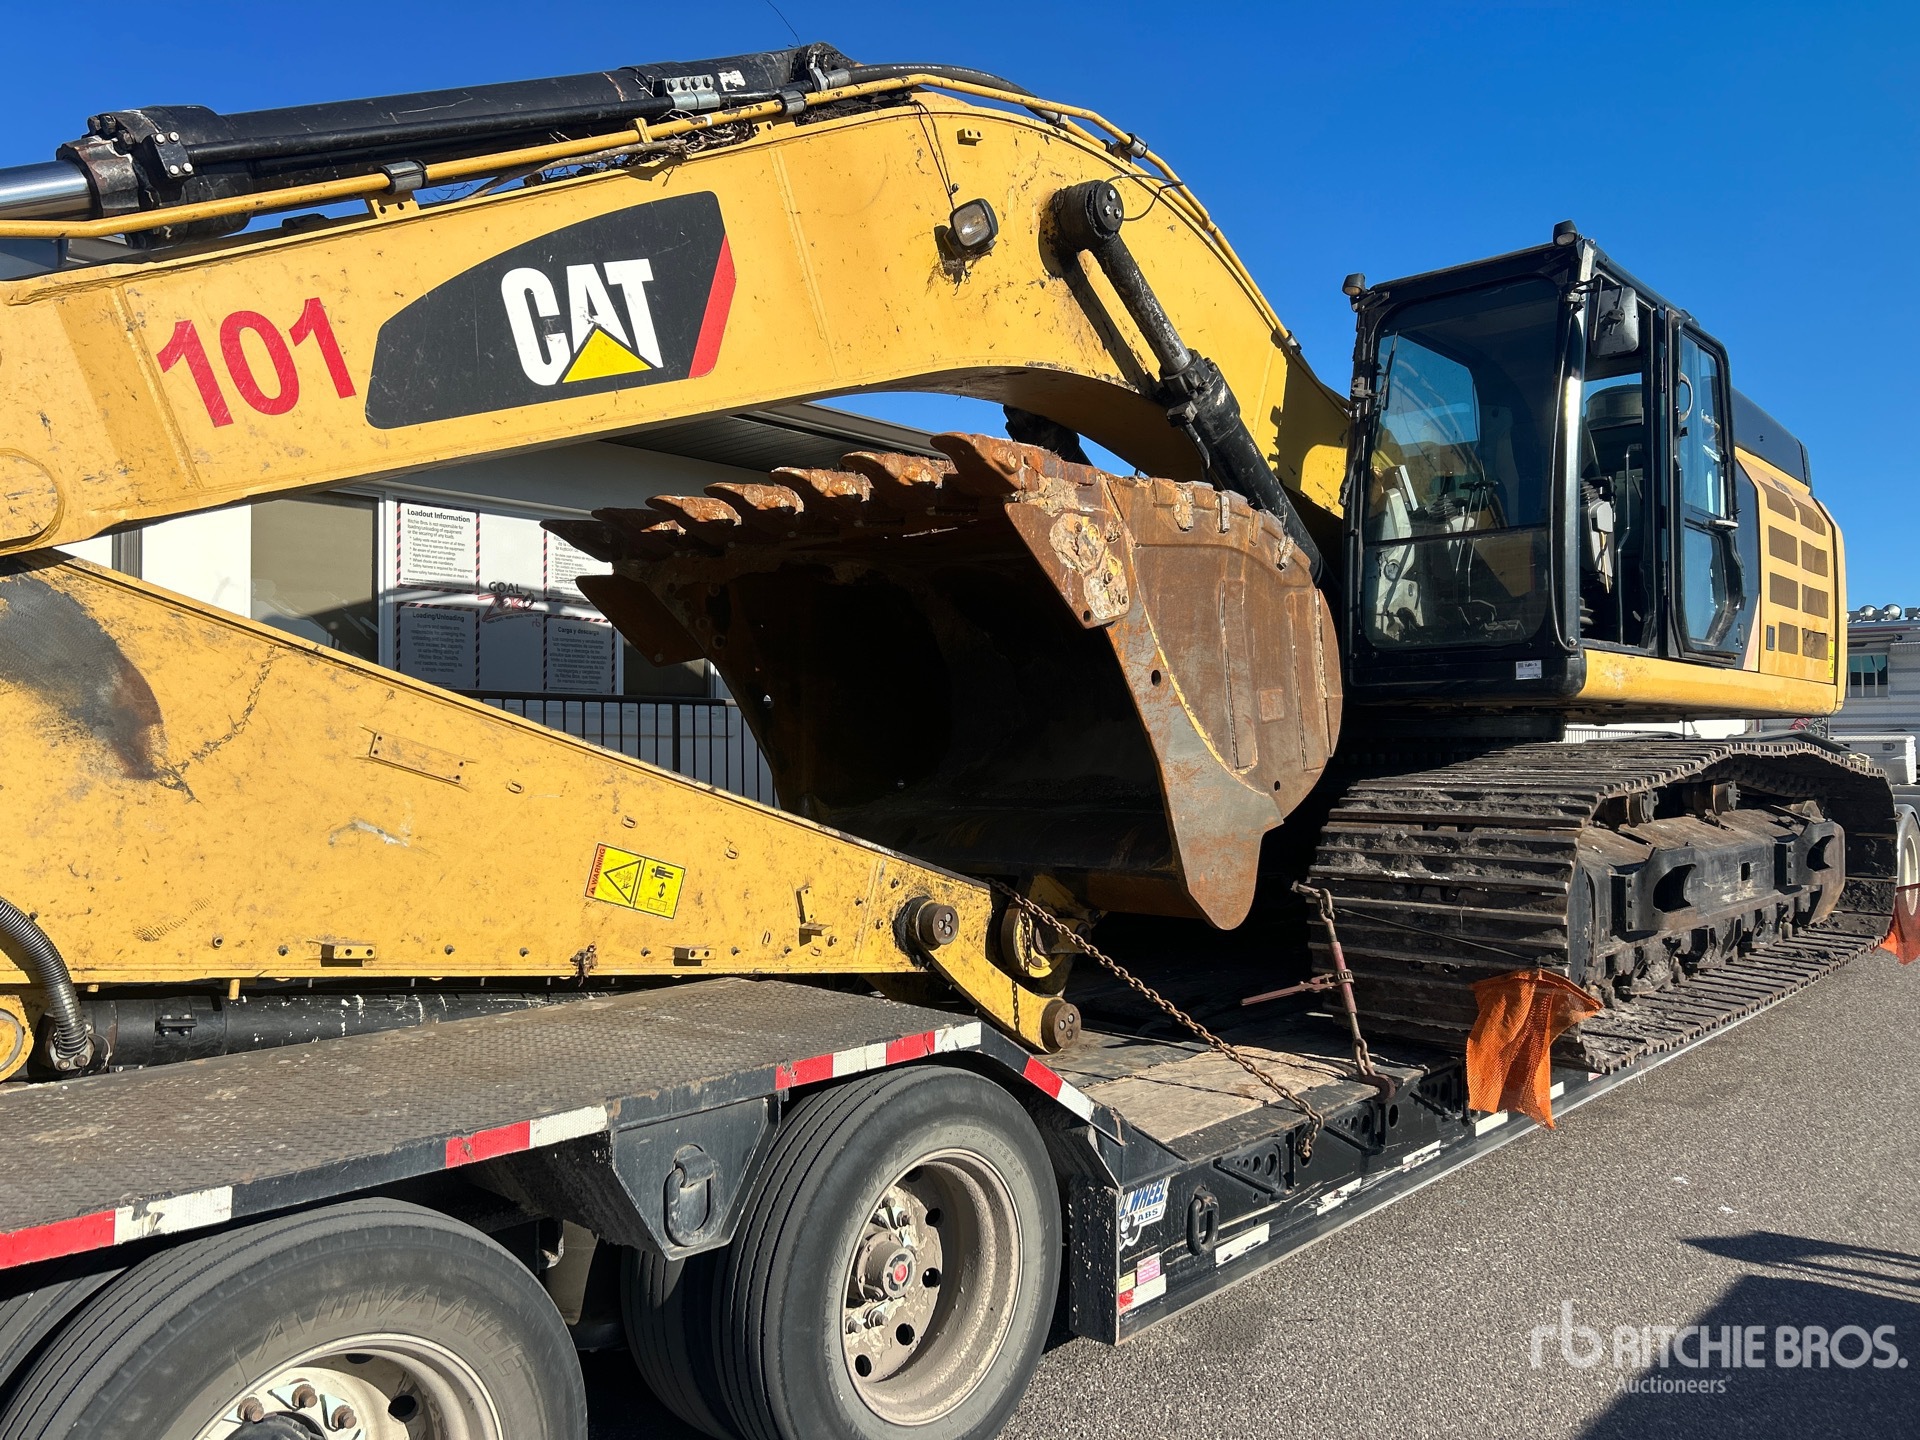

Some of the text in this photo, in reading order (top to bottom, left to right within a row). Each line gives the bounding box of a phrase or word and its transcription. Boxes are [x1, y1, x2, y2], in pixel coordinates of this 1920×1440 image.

[501, 258, 664, 386] CAT
[156, 297, 356, 427] 101
[408, 509, 470, 522] Loadout Information
[489, 581, 522, 594] GOAL
[413, 612, 464, 622] Loading/Unloading
[591, 848, 606, 884] WARNING
[1138, 1208, 1158, 1221] ABS
